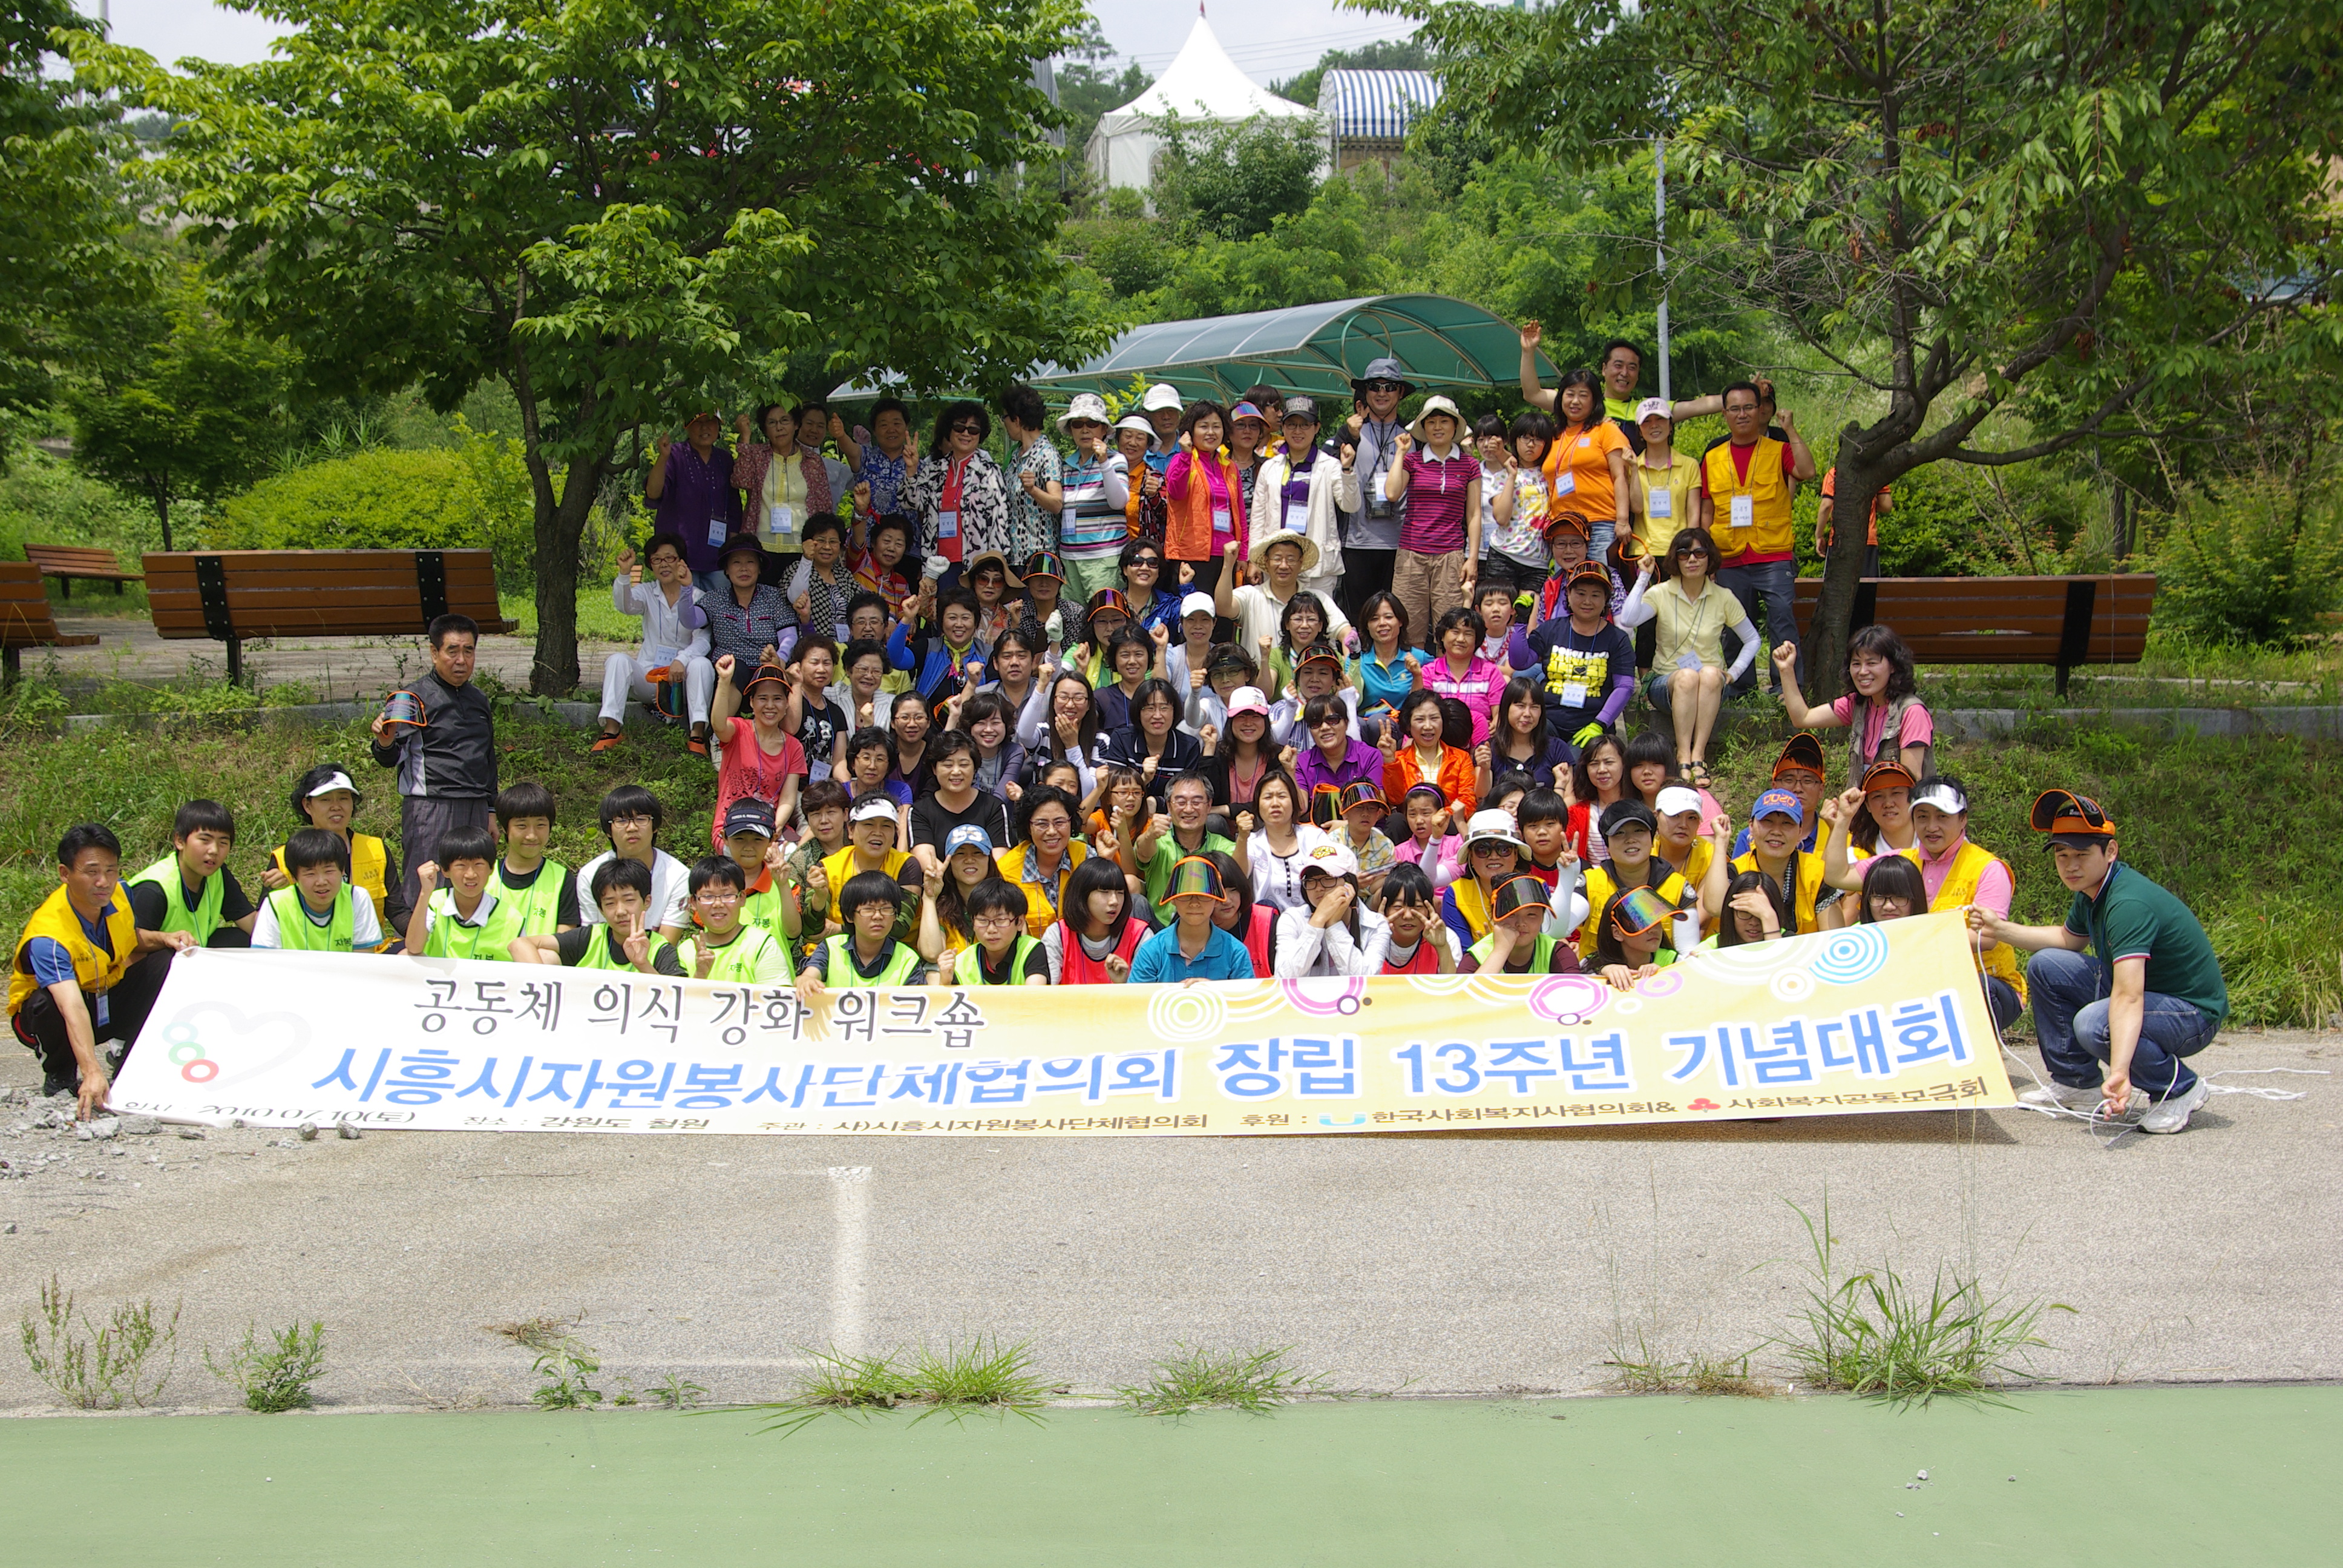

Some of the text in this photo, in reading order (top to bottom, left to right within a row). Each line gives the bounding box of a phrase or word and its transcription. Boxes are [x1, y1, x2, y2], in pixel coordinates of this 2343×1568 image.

[334, 937, 352, 947] 자봉
[752, 917, 770, 928] 자봉
[414, 979, 985, 1048] 공동체 의식 강화 워크숍
[312, 1048, 1176, 1109] 시흥시자원봉사단체협의회
[1396, 1033, 1629, 1094] 13주년
[1670, 995, 1967, 1086] 기념대회
[197, 1105, 415, 1123] 201007.10(토)
[463, 1116, 508, 1125] 장소
[540, 1117, 631, 1128] 강원도
[649, 1119, 710, 1129] 철원
[757, 1122, 807, 1131] 주관
[833, 1114, 1208, 1131] 사)시흥시자원봉사단체협의회
[1240, 1114, 1289, 1126] 후원
[1728, 1076, 1989, 1109] 사회복지공동모금회
